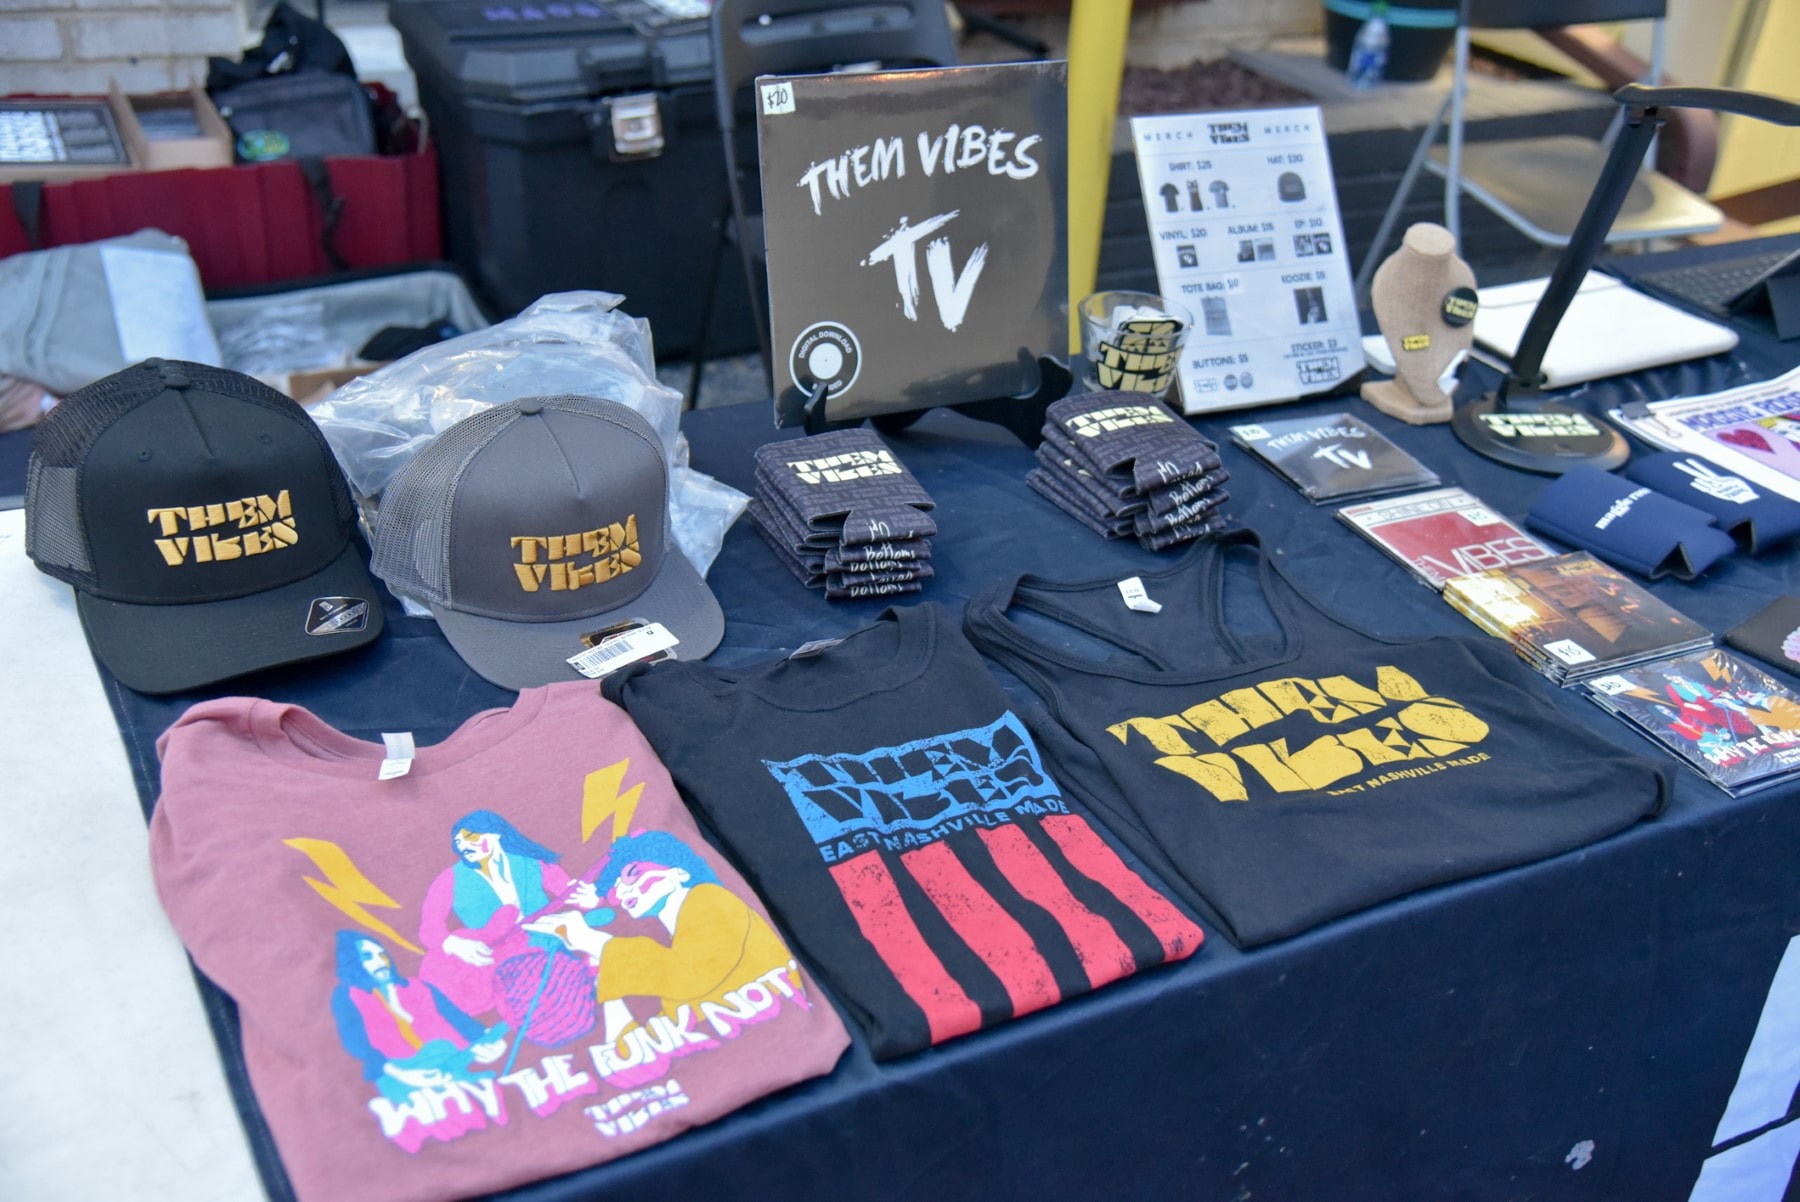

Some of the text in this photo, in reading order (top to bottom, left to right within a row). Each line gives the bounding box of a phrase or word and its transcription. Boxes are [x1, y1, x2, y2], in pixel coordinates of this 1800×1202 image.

[766, 88, 788, 109] $20
[1143, 131, 1194, 142] MERCH
[1263, 124, 1311, 134] MERCH
[796, 124, 1043, 216] THEM VIBES
[1267, 156, 1283, 165] HAT:
[859, 209, 990, 333] TV
[1181, 283, 1203, 294] TOTE
[798, 330, 853, 358] DIGITAL DOWNLOAD
[1065, 406, 1166, 428] THEM
[1267, 425, 1367, 451] THEM VIBES
[786, 450, 895, 474] THEM
[795, 462, 903, 485] VIBES
[1310, 443, 1373, 471] TV
[147, 489, 293, 537] THEM
[154, 517, 299, 567] VIBES
[510, 513, 639, 565] THEM
[1421, 537, 1549, 576] VIBES
[513, 541, 643, 593] VIBES
[1413, 557, 1446, 582] THEM
[1105, 665, 1430, 756] THEM
[1153, 697, 1490, 802] VIBES
[1703, 743, 1746, 766] WHY
[1735, 737, 1769, 756] THE
[1366, 762, 1447, 788] NASHVILLE
[1445, 752, 1491, 767] MADE
[819, 799, 1071, 862] EAST NASHVILLE MADE
[368, 1074, 506, 1150] WHY
[498, 1054, 594, 1114] THE
[588, 1003, 714, 1084] FUNK
[584, 1078, 684, 1121] THEM
[593, 1094, 691, 1137] VIBES
